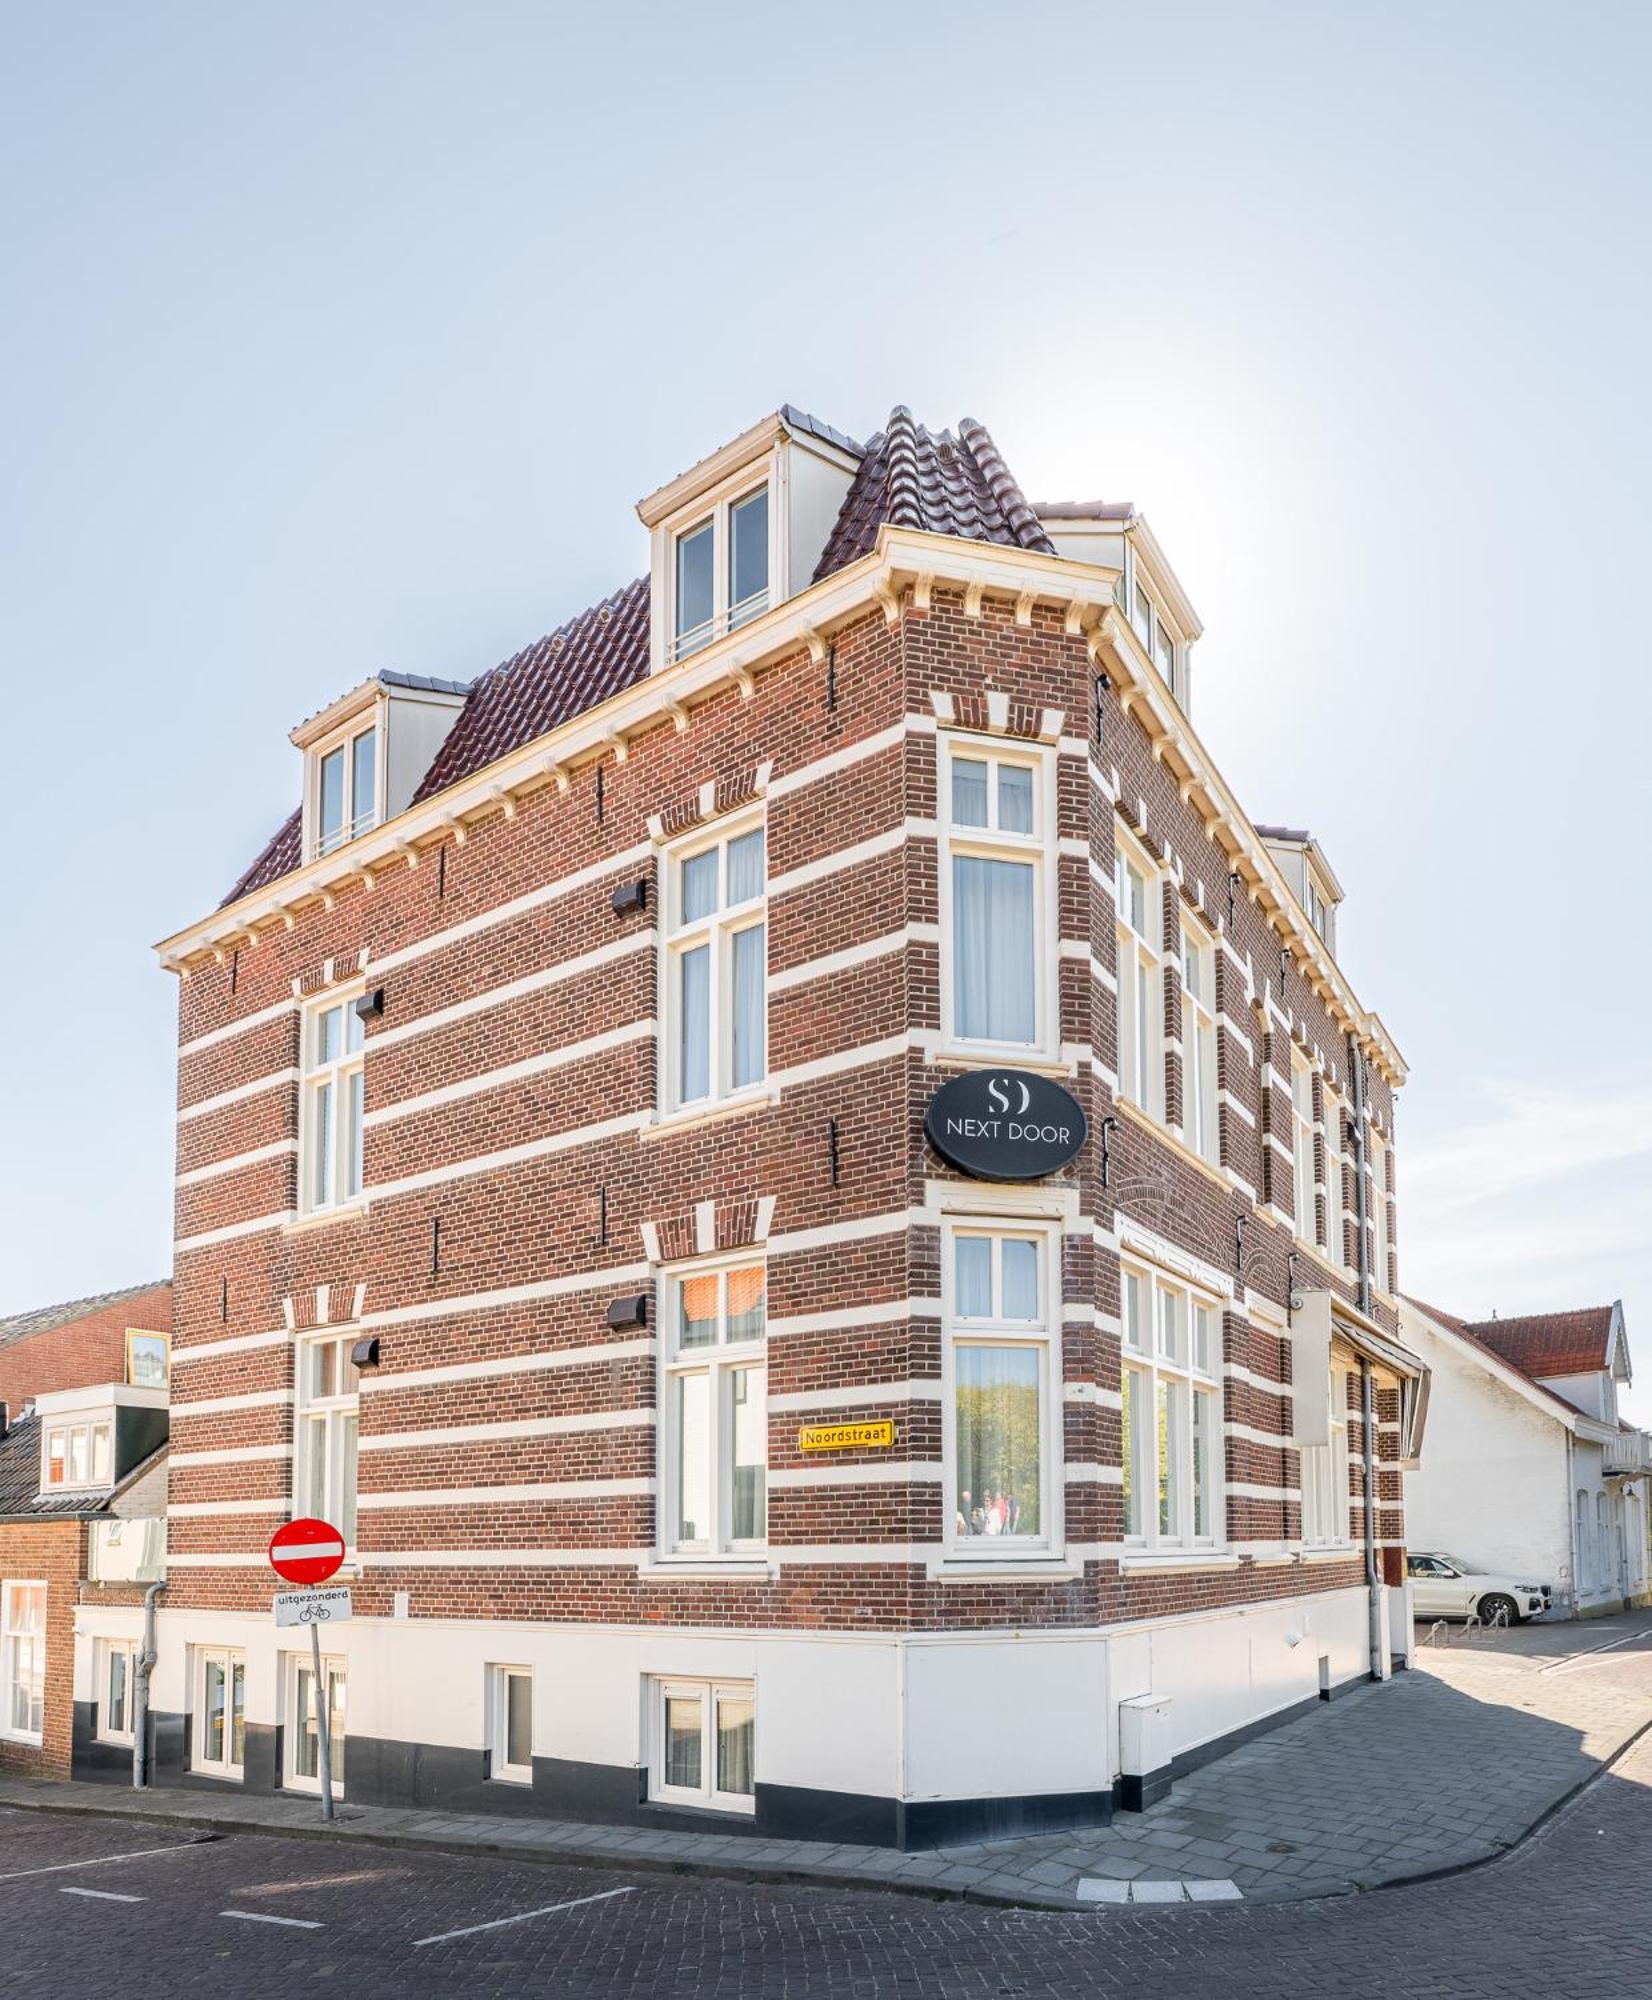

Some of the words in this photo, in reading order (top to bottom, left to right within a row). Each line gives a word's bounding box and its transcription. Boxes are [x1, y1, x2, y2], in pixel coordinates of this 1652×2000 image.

[947, 1118, 1001, 1138] NEXT
[1009, 1123, 1070, 1144] DOOR
[806, 1428, 886, 1444] Noordstraat
[278, 1590, 349, 1605] uitgezonderd
